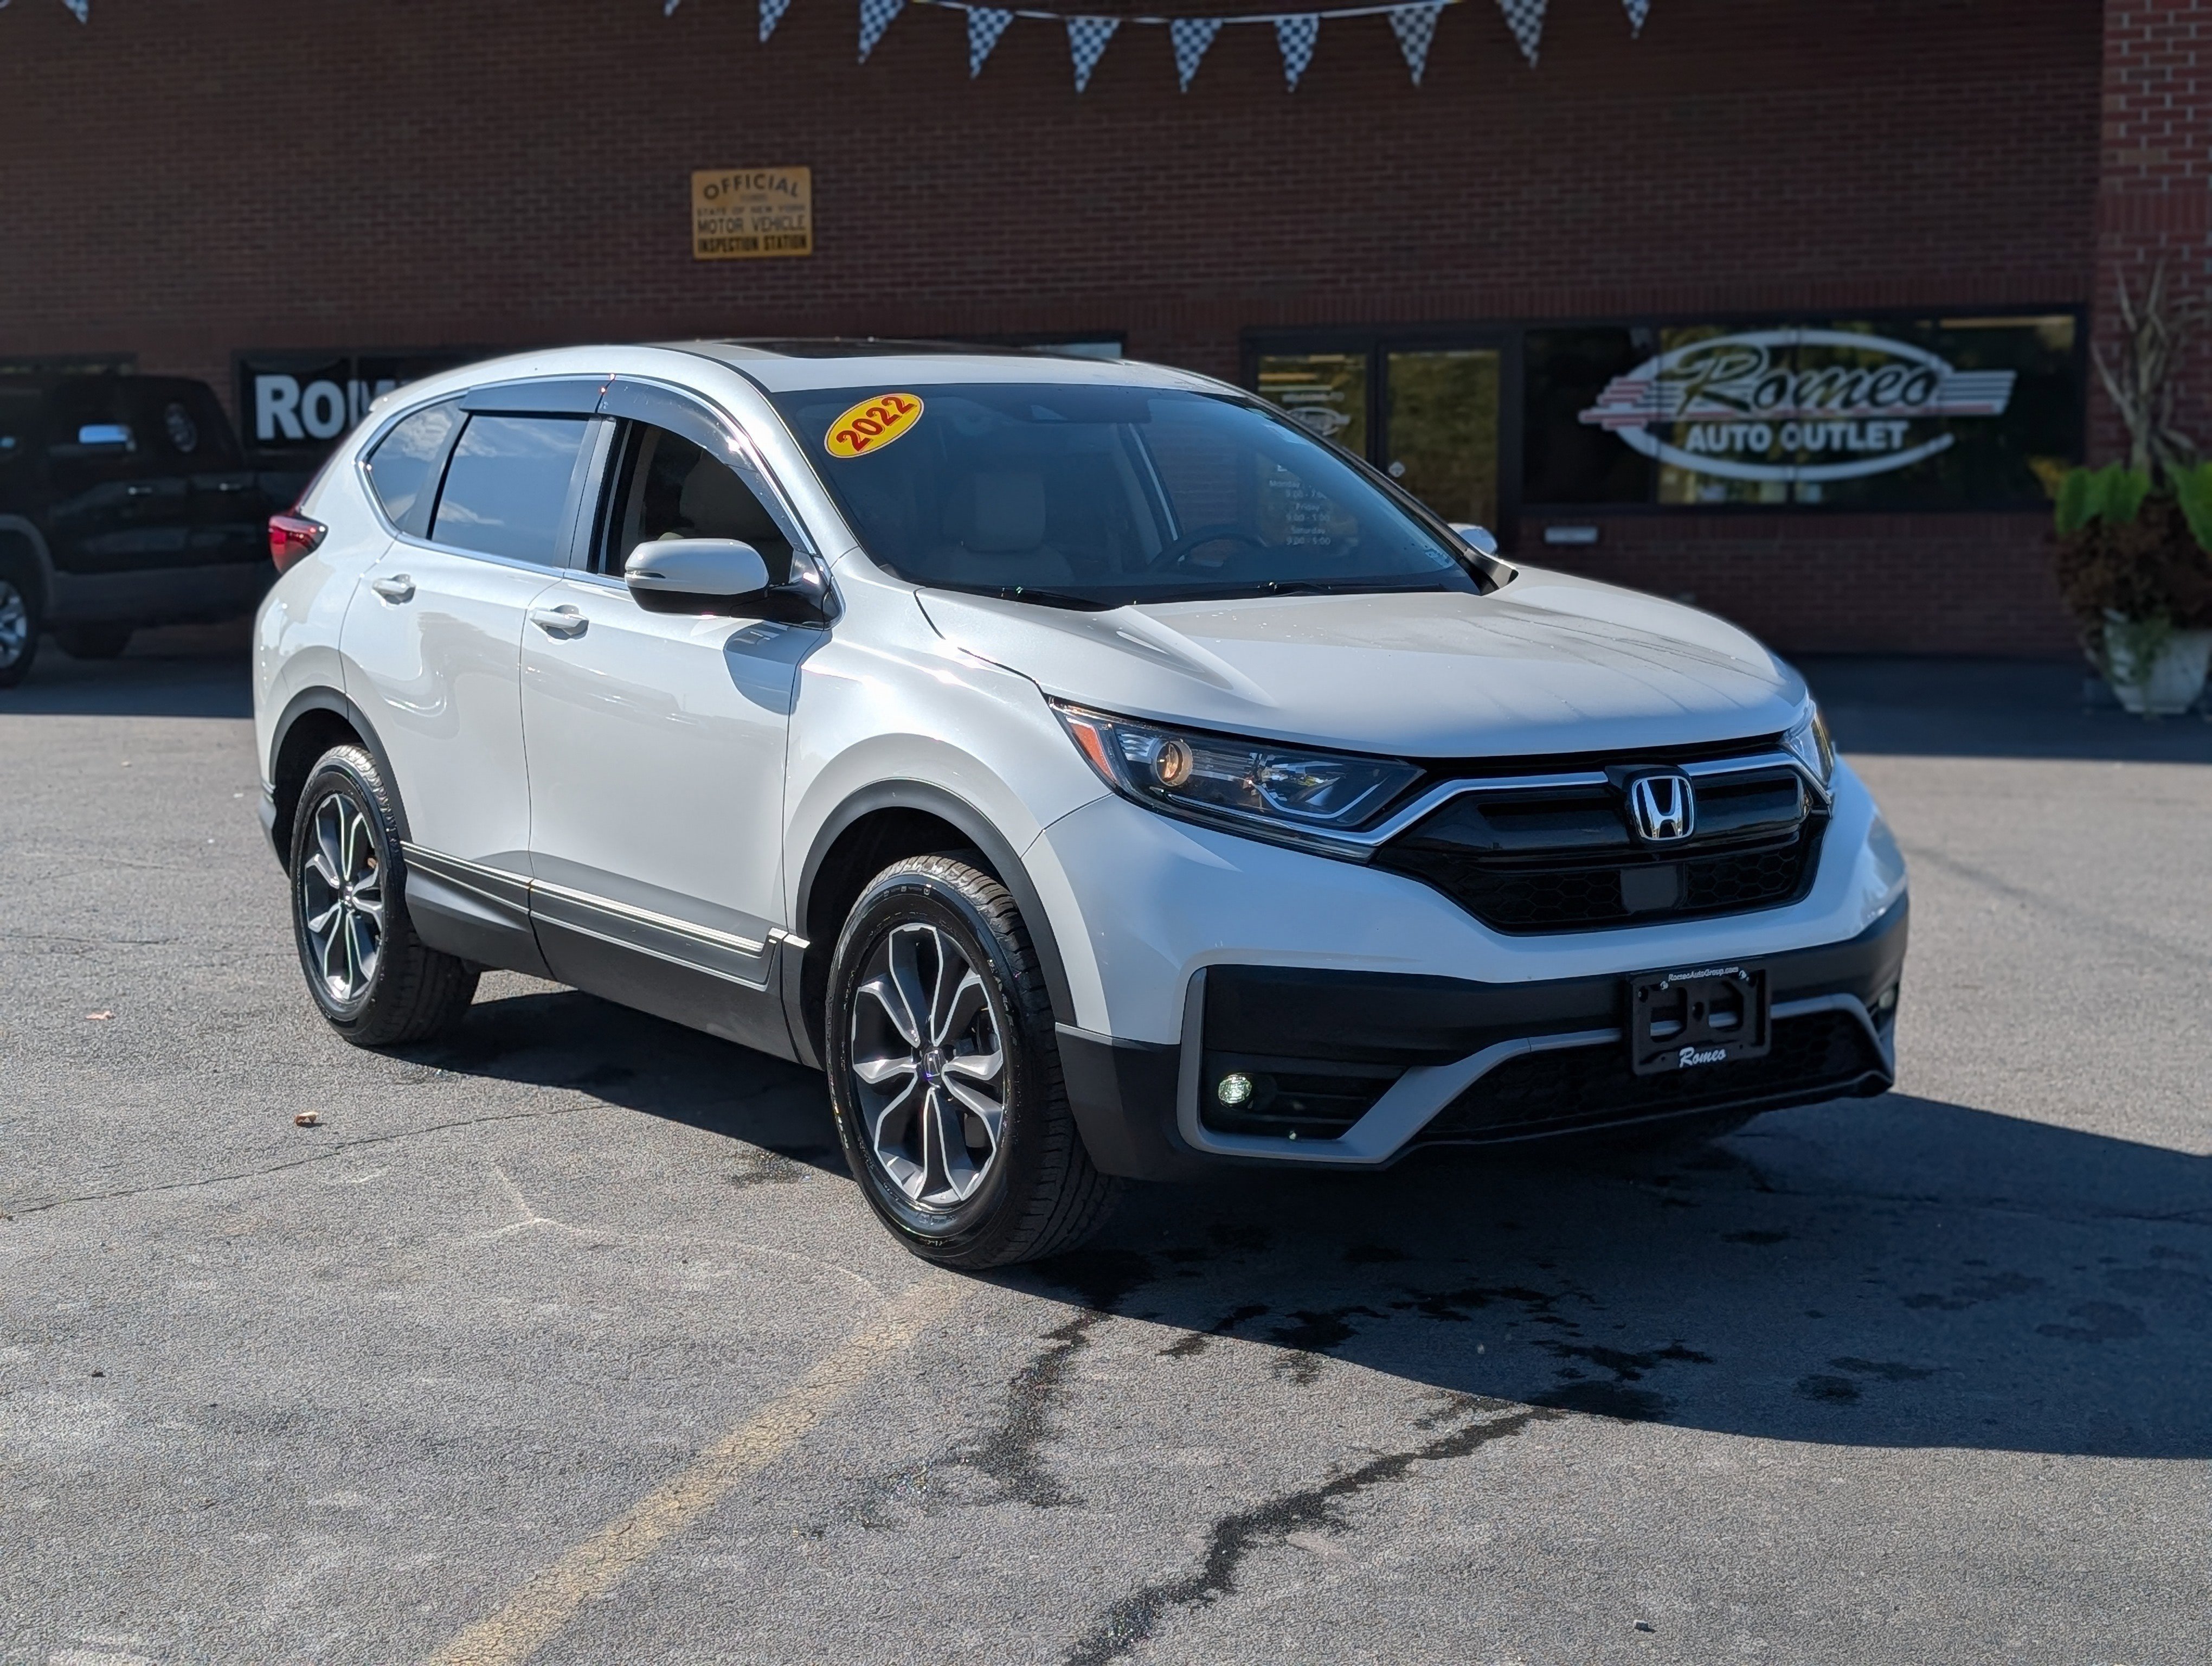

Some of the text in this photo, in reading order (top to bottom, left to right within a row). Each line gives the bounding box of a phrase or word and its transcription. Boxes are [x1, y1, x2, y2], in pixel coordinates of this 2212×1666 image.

[703, 173, 799, 201] OFFICIAL
[698, 215, 806, 234] MOTOR VEHICLE
[698, 234, 807, 253] INSPECTION STATION
[1658, 344, 1939, 415] Romeo
[255, 374, 413, 440] ROM
[835, 396, 917, 452] 2022
[1684, 420, 1909, 453] AUTO OUTLET
[1679, 1046, 1727, 1068] Romeo
